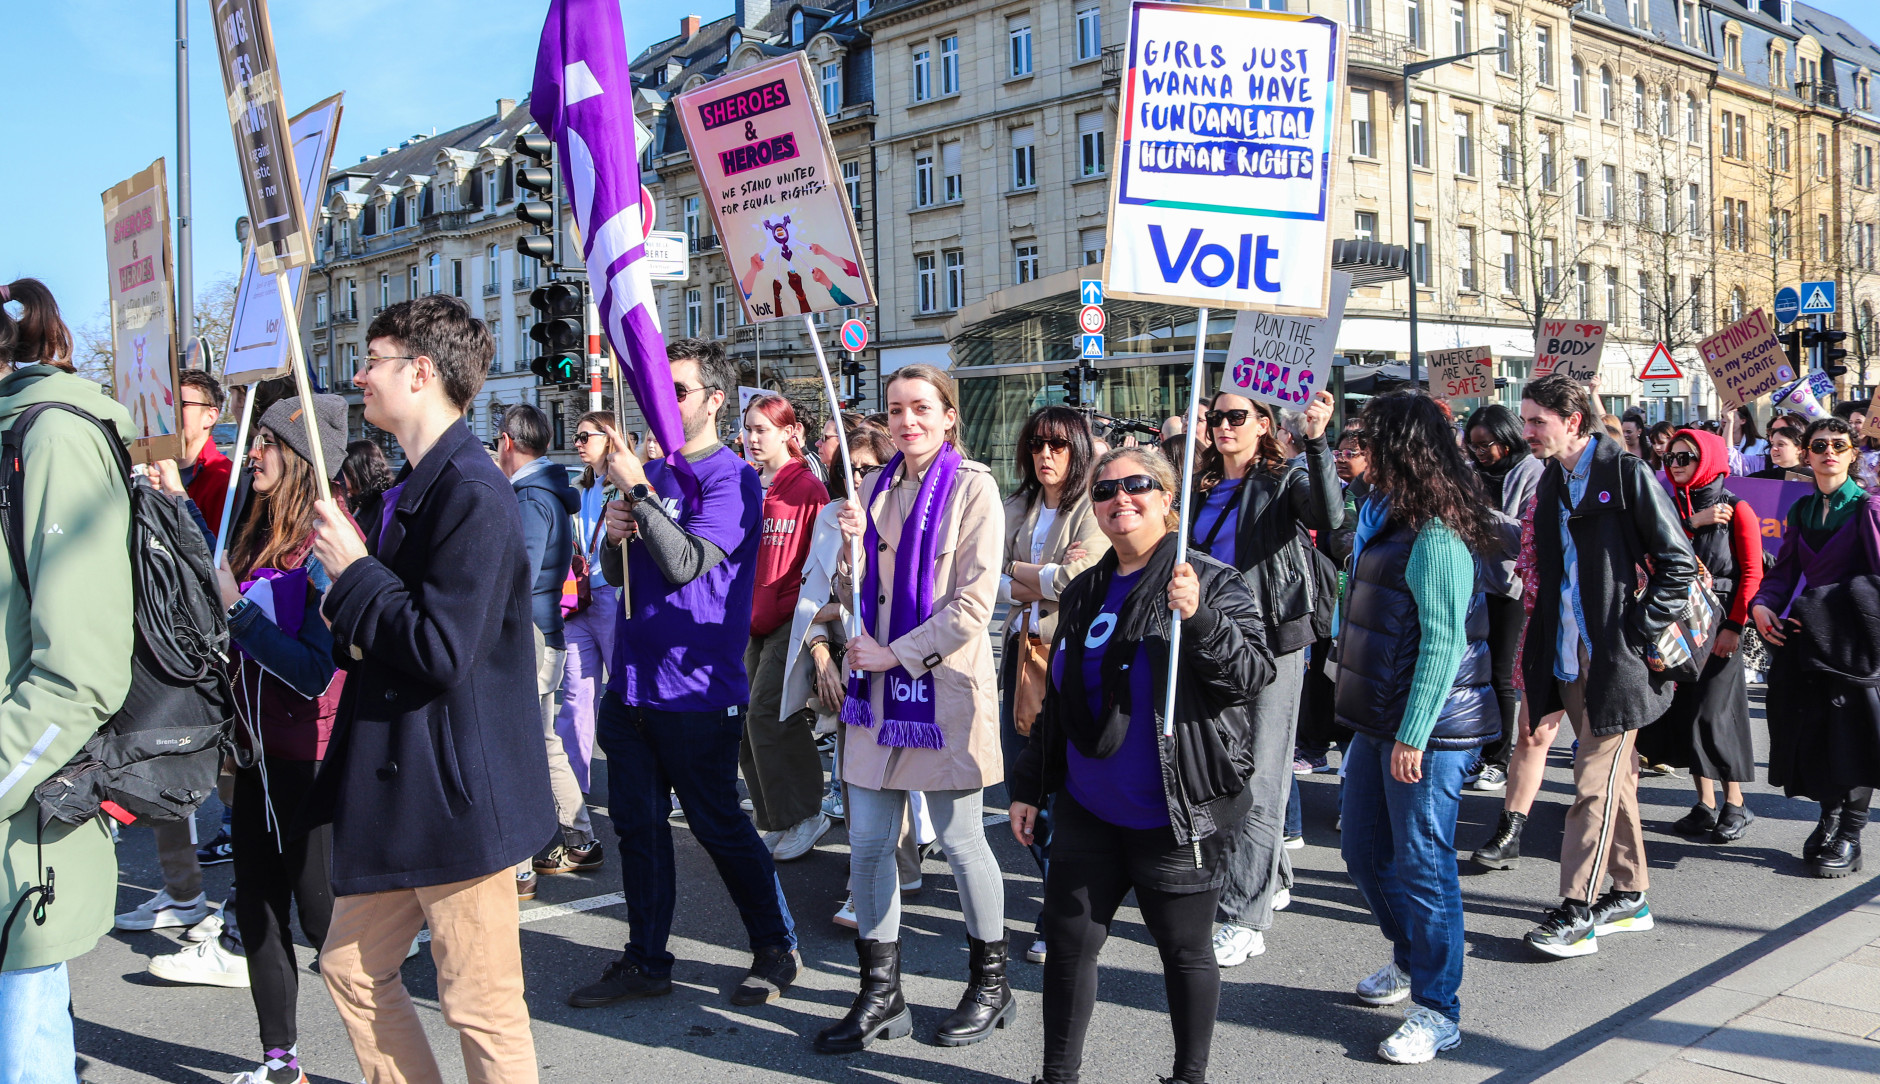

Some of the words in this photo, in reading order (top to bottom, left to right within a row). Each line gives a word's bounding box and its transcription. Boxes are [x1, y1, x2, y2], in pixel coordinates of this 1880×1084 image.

[1144, 39, 1226, 69] GIRLS
[1242, 46, 1309, 74] JUST
[1142, 69, 1233, 98] WANNA
[1249, 74, 1312, 102] HAVE
[704, 83, 785, 127] SHEROES
[745, 120, 758, 142] &
[722, 134, 796, 175] HEROES
[1140, 140, 1227, 173] HUMAN
[1236, 146, 1313, 177] RIGHTS
[722, 187, 736, 200] WE
[741, 178, 772, 196] STAND
[777, 166, 815, 185] UNITED
[721, 203, 739, 216] FOR
[743, 194, 776, 210] EQUAL
[114, 206, 152, 244] SHEROES
[132, 239, 138, 260] &
[1147, 224, 1281, 292] Volt
[121, 257, 152, 291] HEROES
[751, 302, 773, 316] Volt
[1086, 313, 1100, 326] 30
[1254, 313, 1284, 339] RUN
[1289, 320, 1316, 346] THE
[1543, 321, 1567, 337] MY
[1701, 310, 1767, 363] FEMINIST
[1252, 336, 1315, 368] WORLD?
[1430, 350, 1475, 368] WHERE
[1537, 353, 1559, 368] MY
[1547, 338, 1596, 356] BODY
[1712, 367, 1723, 378] is
[1725, 357, 1740, 373] my
[1742, 334, 1778, 363] second
[1233, 357, 1314, 405] GIRLS
[1442, 366, 1460, 381] ARE
[1464, 364, 1482, 376] WE
[1554, 360, 1596, 381] Choice
[1726, 354, 1777, 389] FAVORITE
[1447, 375, 1488, 397] SAFE?
[763, 518, 796, 534] ISLAND
[890, 675, 929, 703] Volt
[178, 736, 192, 747] 26
